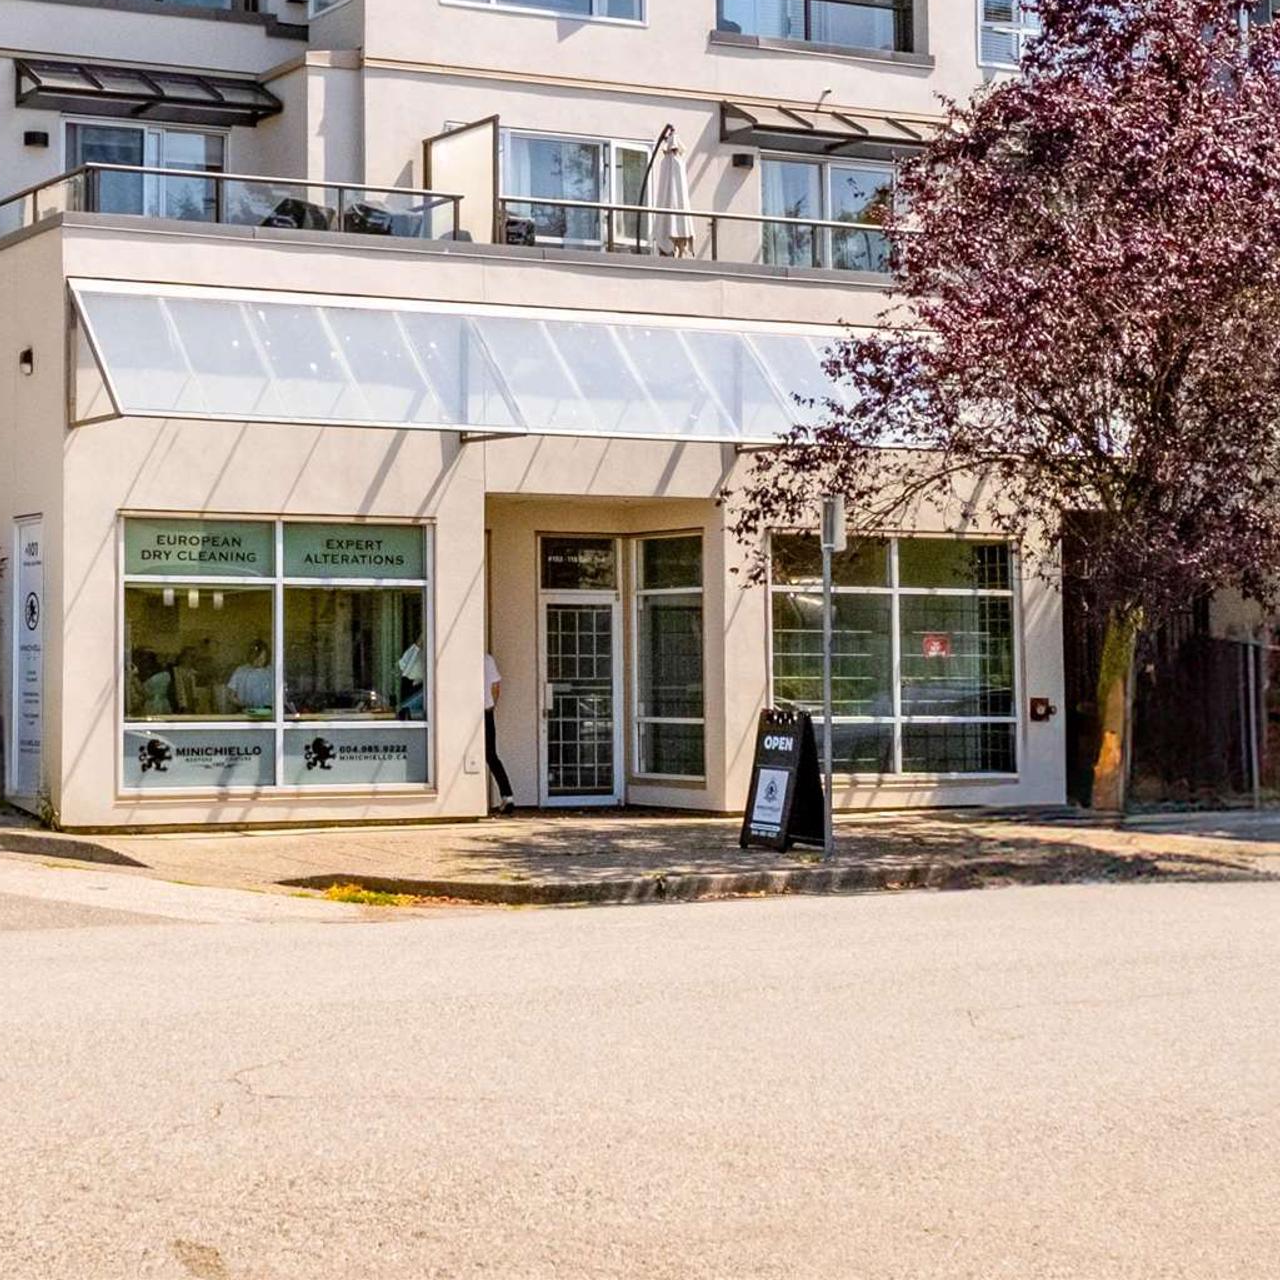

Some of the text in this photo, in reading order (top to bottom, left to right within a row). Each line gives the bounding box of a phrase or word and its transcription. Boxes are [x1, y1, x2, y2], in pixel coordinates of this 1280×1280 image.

[156, 534, 242, 548] EUROPEAN
[326, 539, 383, 551] EXPERT
[141, 549, 257, 563] DRY CLEANING
[304, 553, 405, 566] ALTERATIONS
[764, 735, 794, 752] OPEN
[175, 745, 262, 757] MINICHIELLO
